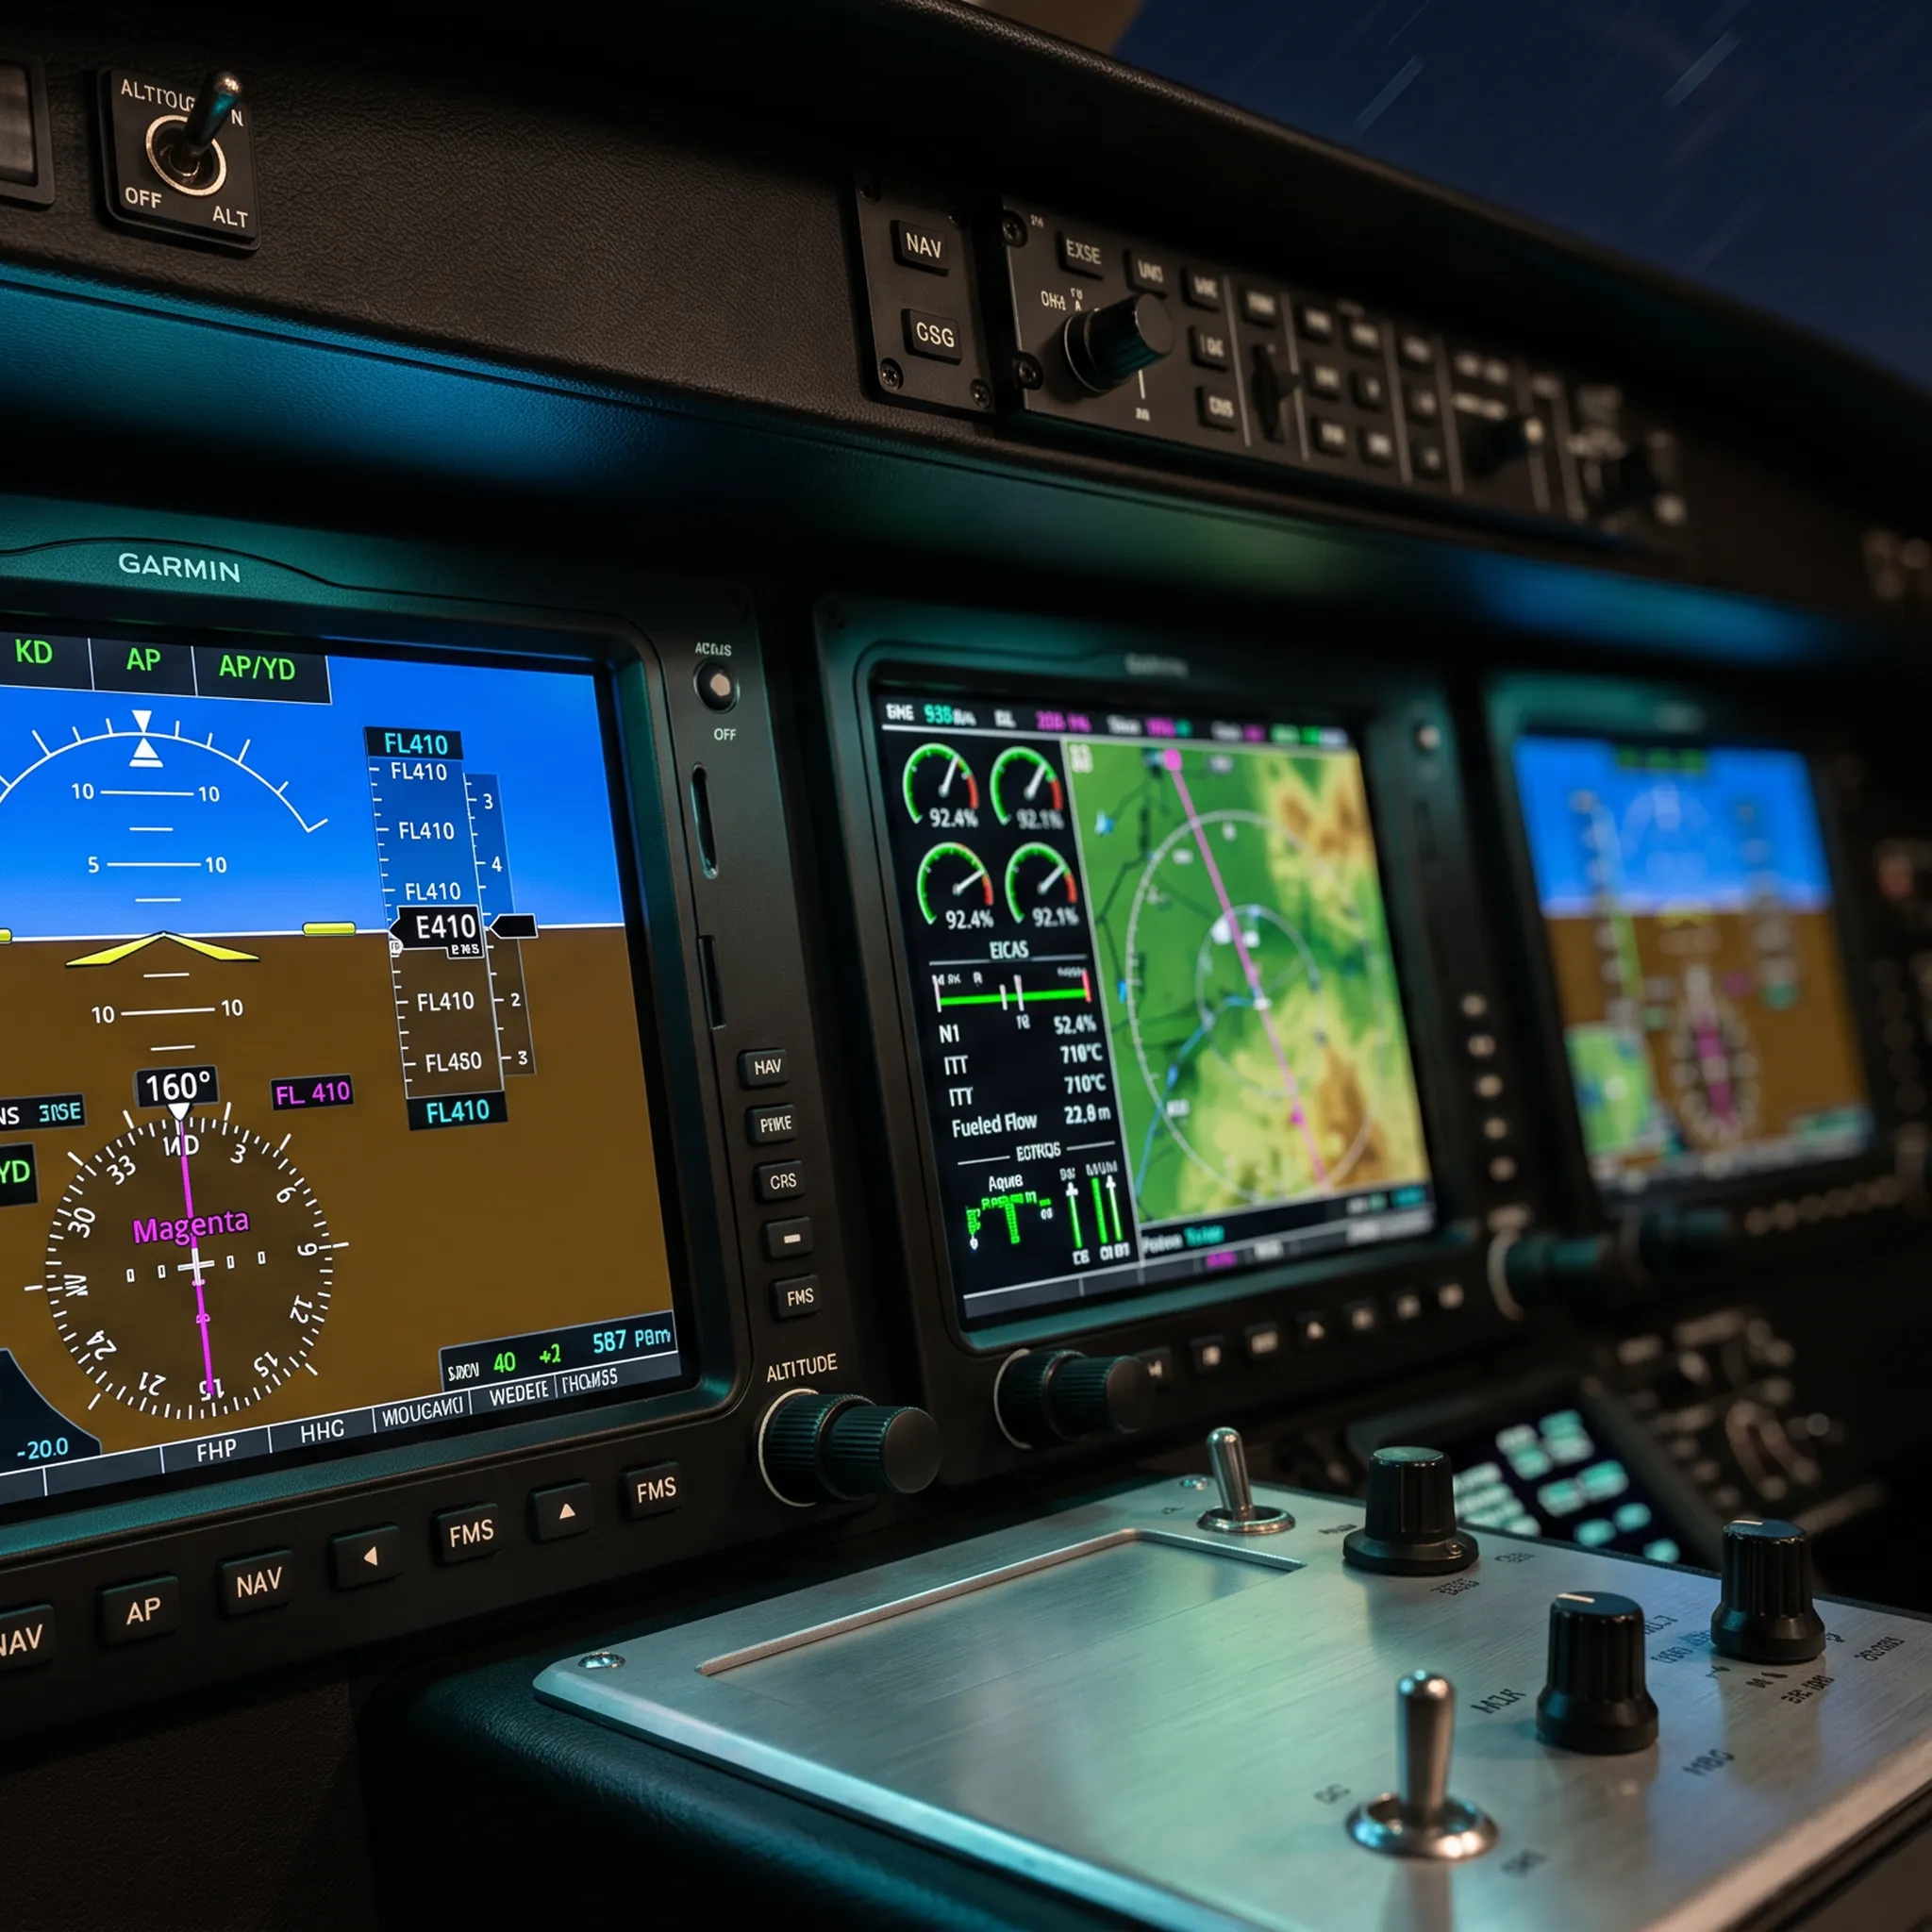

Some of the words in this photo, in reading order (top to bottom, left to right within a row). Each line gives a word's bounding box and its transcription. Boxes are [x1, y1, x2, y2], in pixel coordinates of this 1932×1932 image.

[125, 187, 162, 209] OFF
[212, 206, 248, 228] ALT
[906, 232, 941, 259] NAV
[118, 552, 242, 583] GARMIN
[15, 639, 53, 664] KD
[126, 647, 161, 672] AP
[219, 655, 296, 681] AP/YD
[385, 732, 449, 756] FL410
[713, 727, 737, 741] OFF
[391, 762, 448, 782] FL410
[72, 783, 94, 800] 10
[198, 786, 220, 803] 10
[483, 793, 493, 809] 3
[398, 822, 455, 841] FL410
[88, 857, 99, 874] 5
[206, 857, 227, 874] 10
[491, 857, 503, 873] 4
[405, 882, 461, 901] FL410
[416, 913, 476, 940] E410
[945, 909, 994, 930] 92.4%
[990, 940, 1029, 959] EICAS
[221, 999, 243, 1017] 10
[417, 991, 475, 1012] FL410
[510, 992, 522, 1007] 2
[92, 1006, 115, 1024] 10
[939, 1024, 960, 1043] N1
[518, 1050, 528, 1065] 3
[755, 1058, 782, 1075] NAV
[146, 1071, 210, 1102] 160°
[276, 1086, 305, 1106] FL
[311, 1081, 350, 1102] 410
[426, 1098, 490, 1124] FL410
[952, 1113, 1003, 1138] Fueled
[1005, 1111, 1038, 1132] Flow
[230, 1144, 246, 1165] 3
[106, 1155, 136, 1186] 33
[770, 1173, 797, 1190] CRS
[68, 1208, 96, 1239] 30
[132, 1210, 250, 1246] Magenta
[787, 1287, 814, 1307] FMS
[290, 1295, 313, 1324] 12
[493, 1351, 516, 1373] 40
[592, 1329, 626, 1354] 587
[767, 1353, 838, 1383] ALTITUDE
[301, 1419, 344, 1444] HHG
[17, 1437, 69, 1459] -20.0
[197, 1438, 237, 1462] FHP
[637, 1476, 676, 1504] FMS
[450, 1519, 493, 1548] FMS
[237, 1566, 282, 1598] NAV
[126, 1596, 161, 1625] AP
